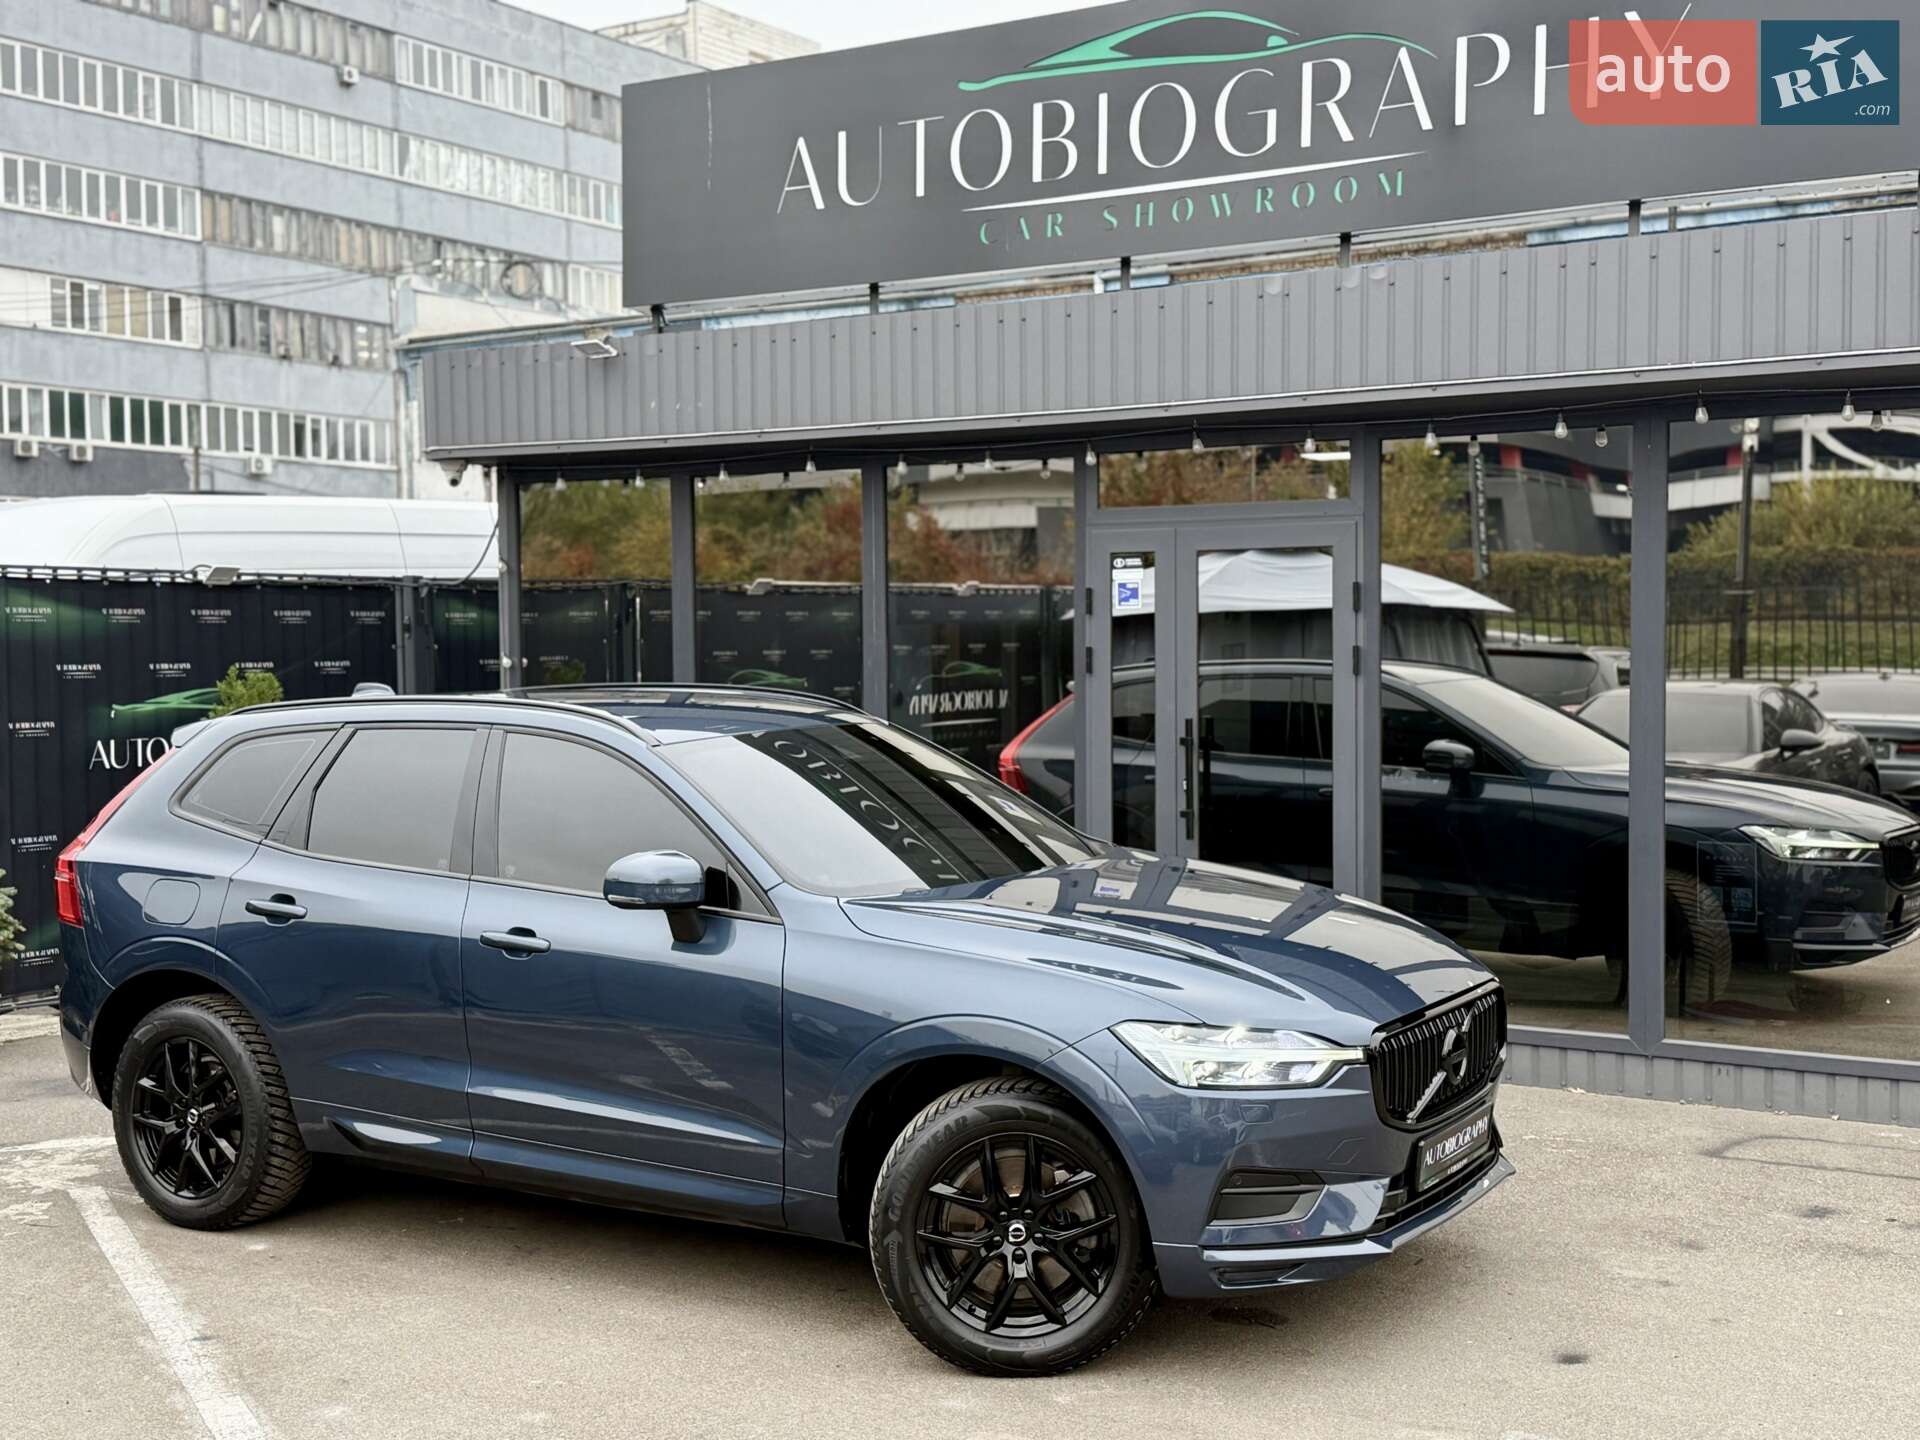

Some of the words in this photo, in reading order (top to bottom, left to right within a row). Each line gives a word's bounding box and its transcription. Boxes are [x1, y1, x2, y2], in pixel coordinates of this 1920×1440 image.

[777, 3, 1692, 214] AUTOBIOGRAPHY
[979, 212, 1065, 246] CAR
[1102, 170, 1403, 230] SHOWROOM
